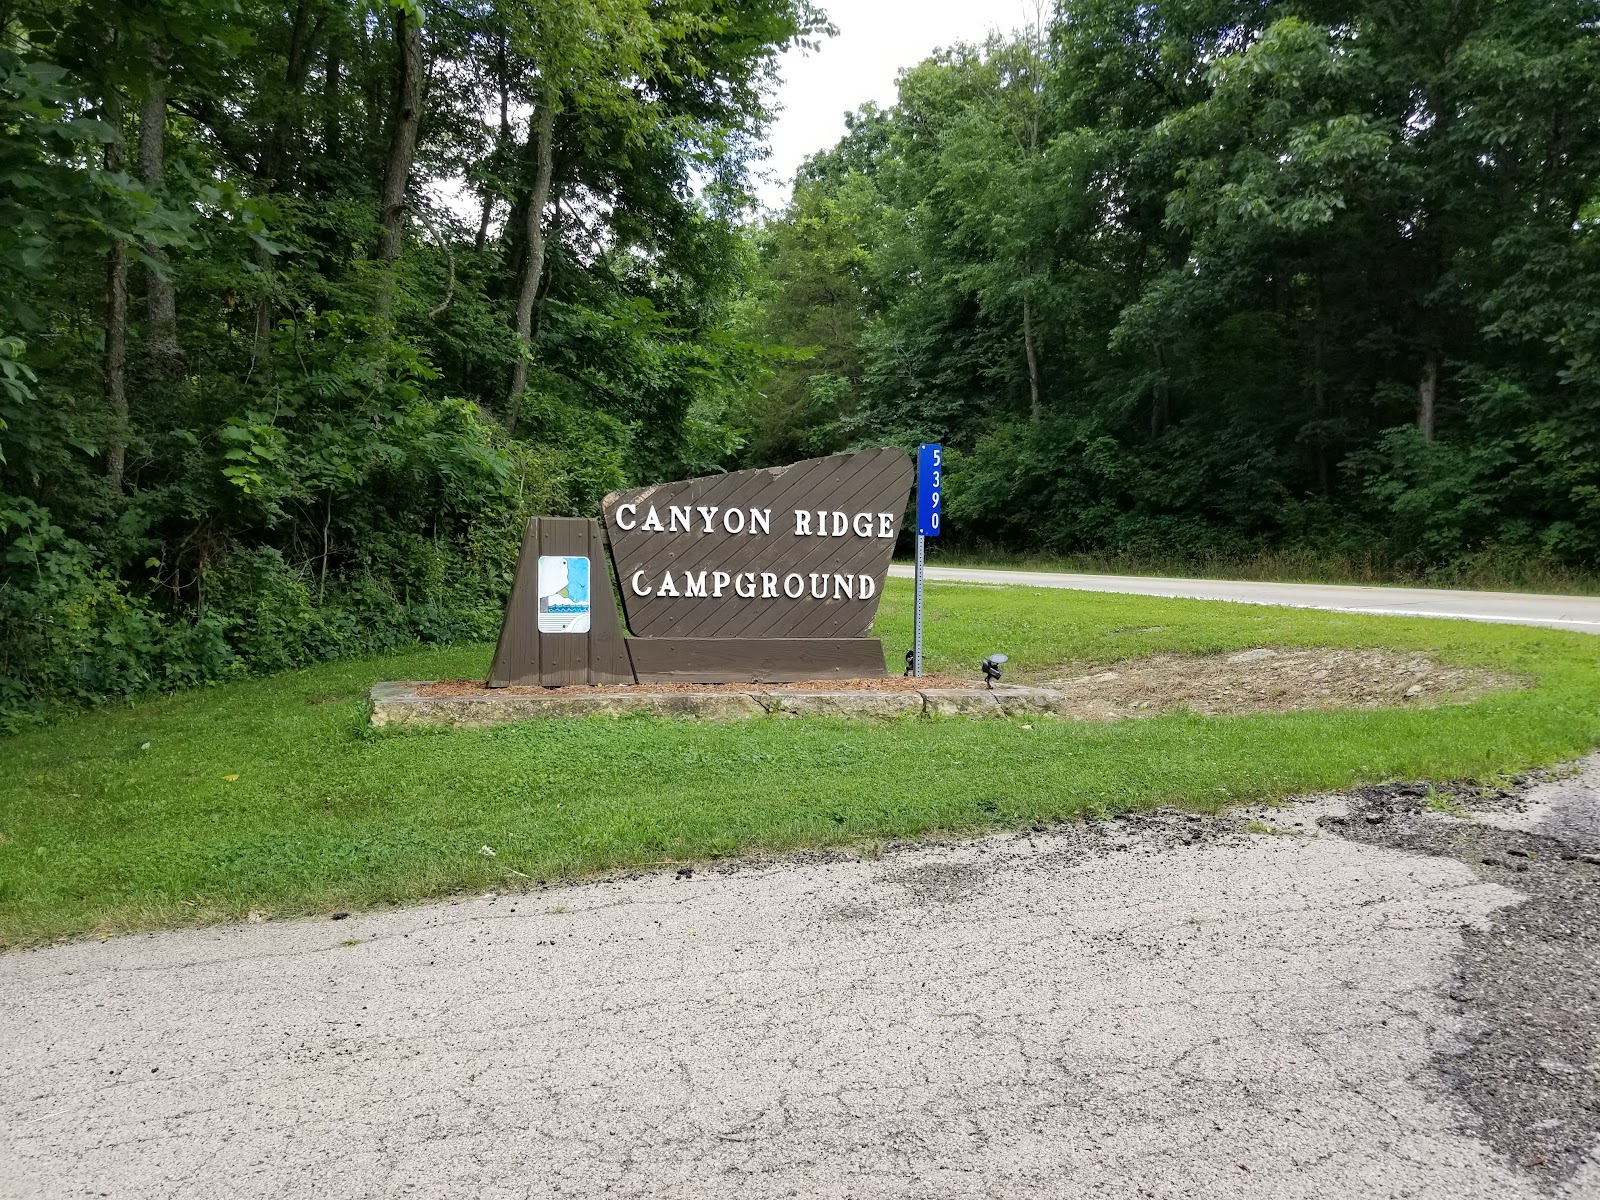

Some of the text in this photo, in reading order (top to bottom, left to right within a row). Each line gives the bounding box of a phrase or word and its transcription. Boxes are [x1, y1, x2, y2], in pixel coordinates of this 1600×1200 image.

[931, 449, 941, 529] 5390
[615, 503, 895, 538] CANYON RIDGE
[631, 570, 876, 600] CAMPGROUND
